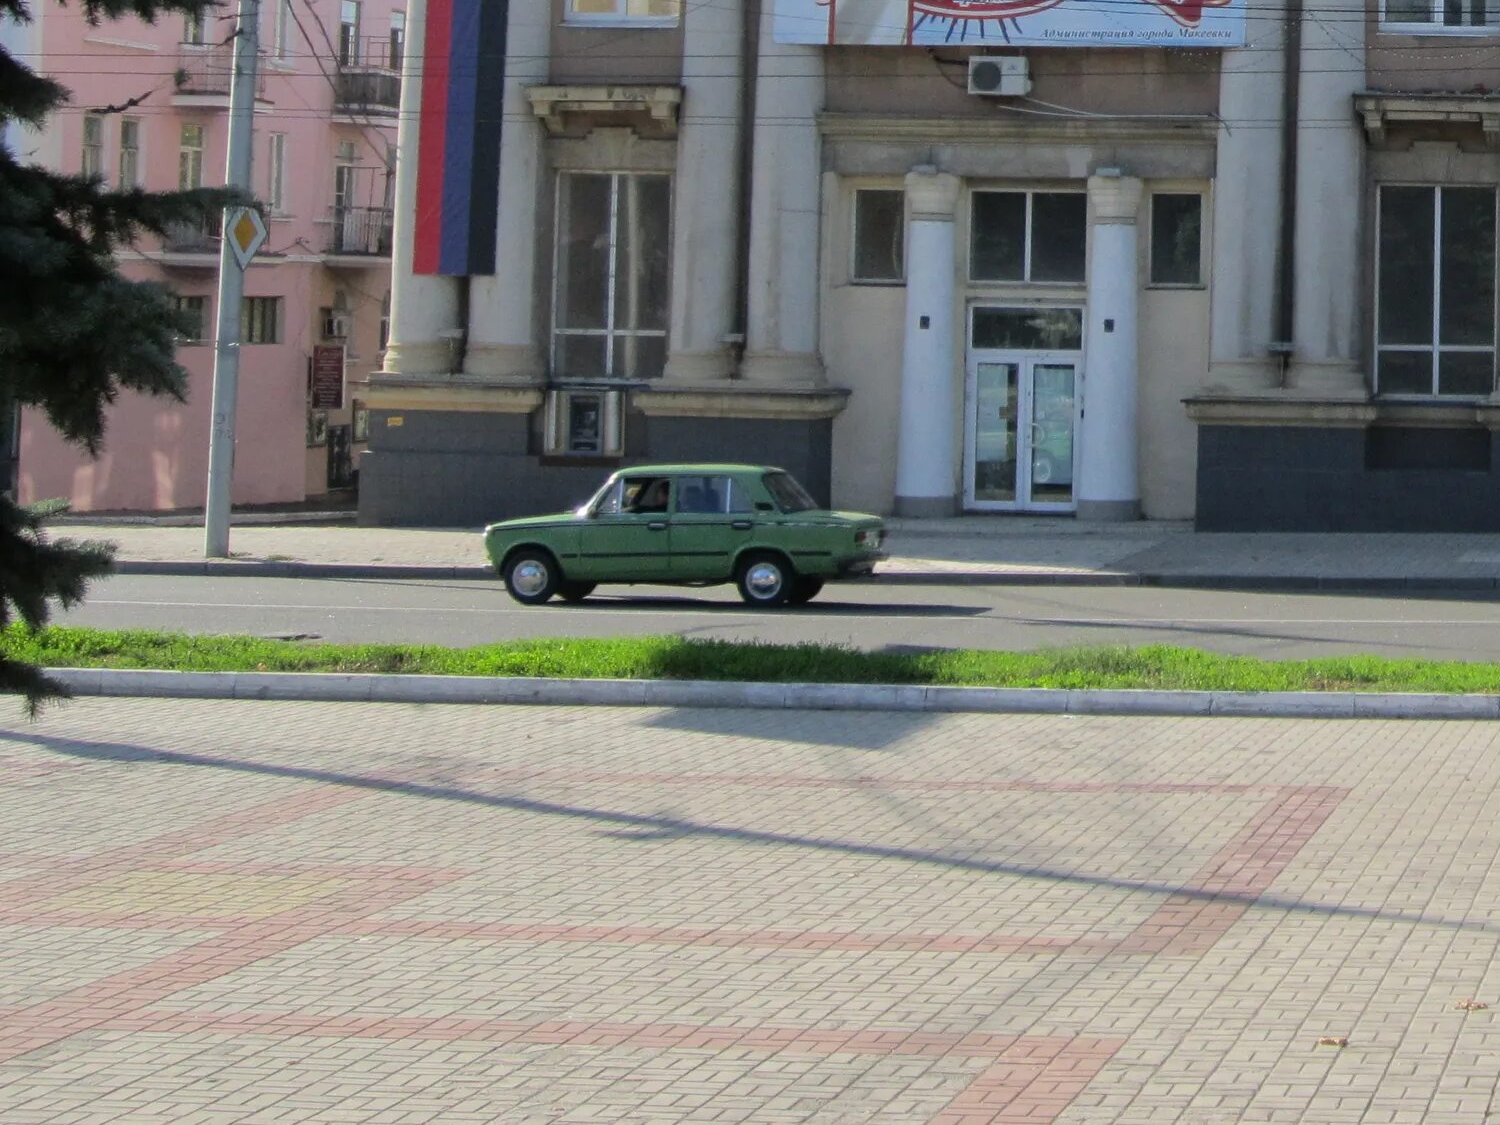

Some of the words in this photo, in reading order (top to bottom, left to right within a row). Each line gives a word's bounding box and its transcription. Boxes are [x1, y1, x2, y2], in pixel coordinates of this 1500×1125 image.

[1040, 29, 1134, 39] Администрация
[1137, 31, 1173, 40] города
[1178, 29, 1232, 38] Макеевки
